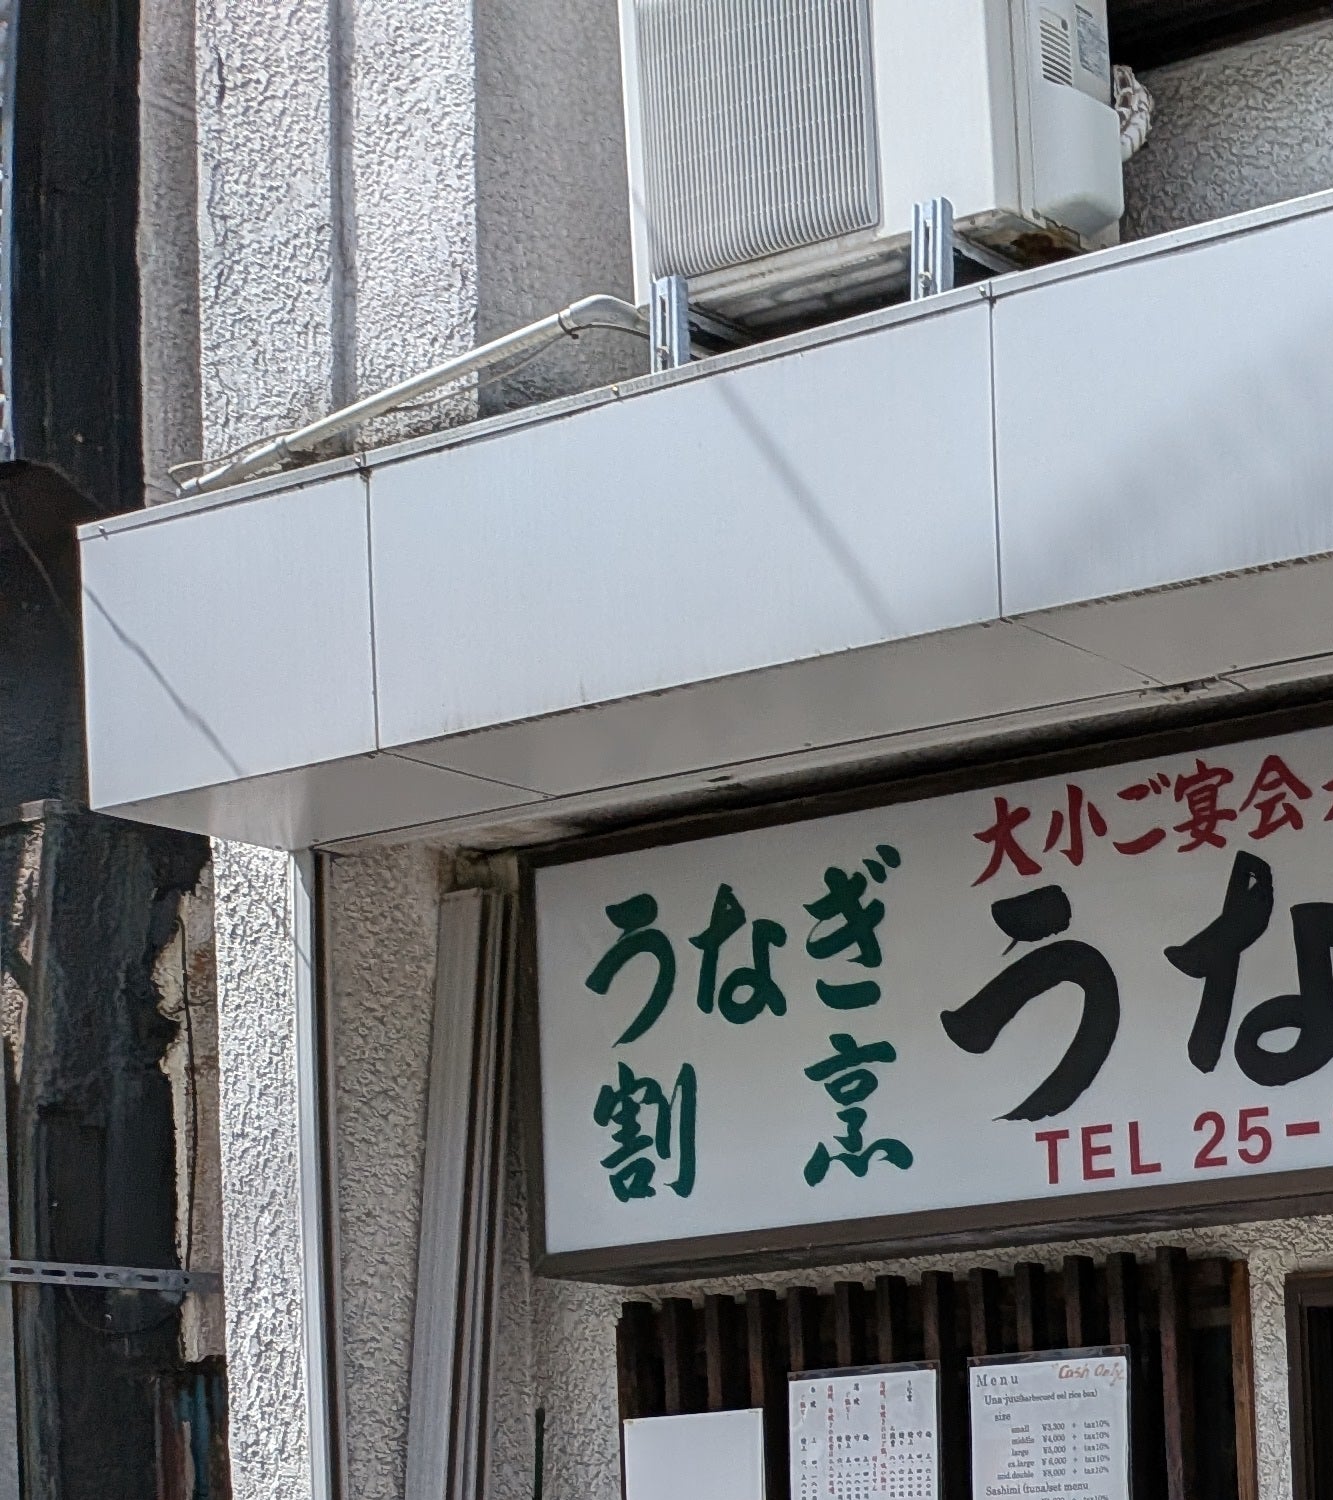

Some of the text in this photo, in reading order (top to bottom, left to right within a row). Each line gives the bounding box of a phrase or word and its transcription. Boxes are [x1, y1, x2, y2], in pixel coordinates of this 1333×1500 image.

[584, 843, 902, 1046] うなぎ
[592, 1034, 913, 1202] 割烹
[1035, 1128, 1162, 1185] TEL
[977, 1375, 1018, 1387] Menu
[994, 1412, 1010, 1421] size
[1011, 1425, 1029, 1433] small
[1012, 1448, 1029, 1456] large
[985, 1485, 1020, 1496] Sashimi
